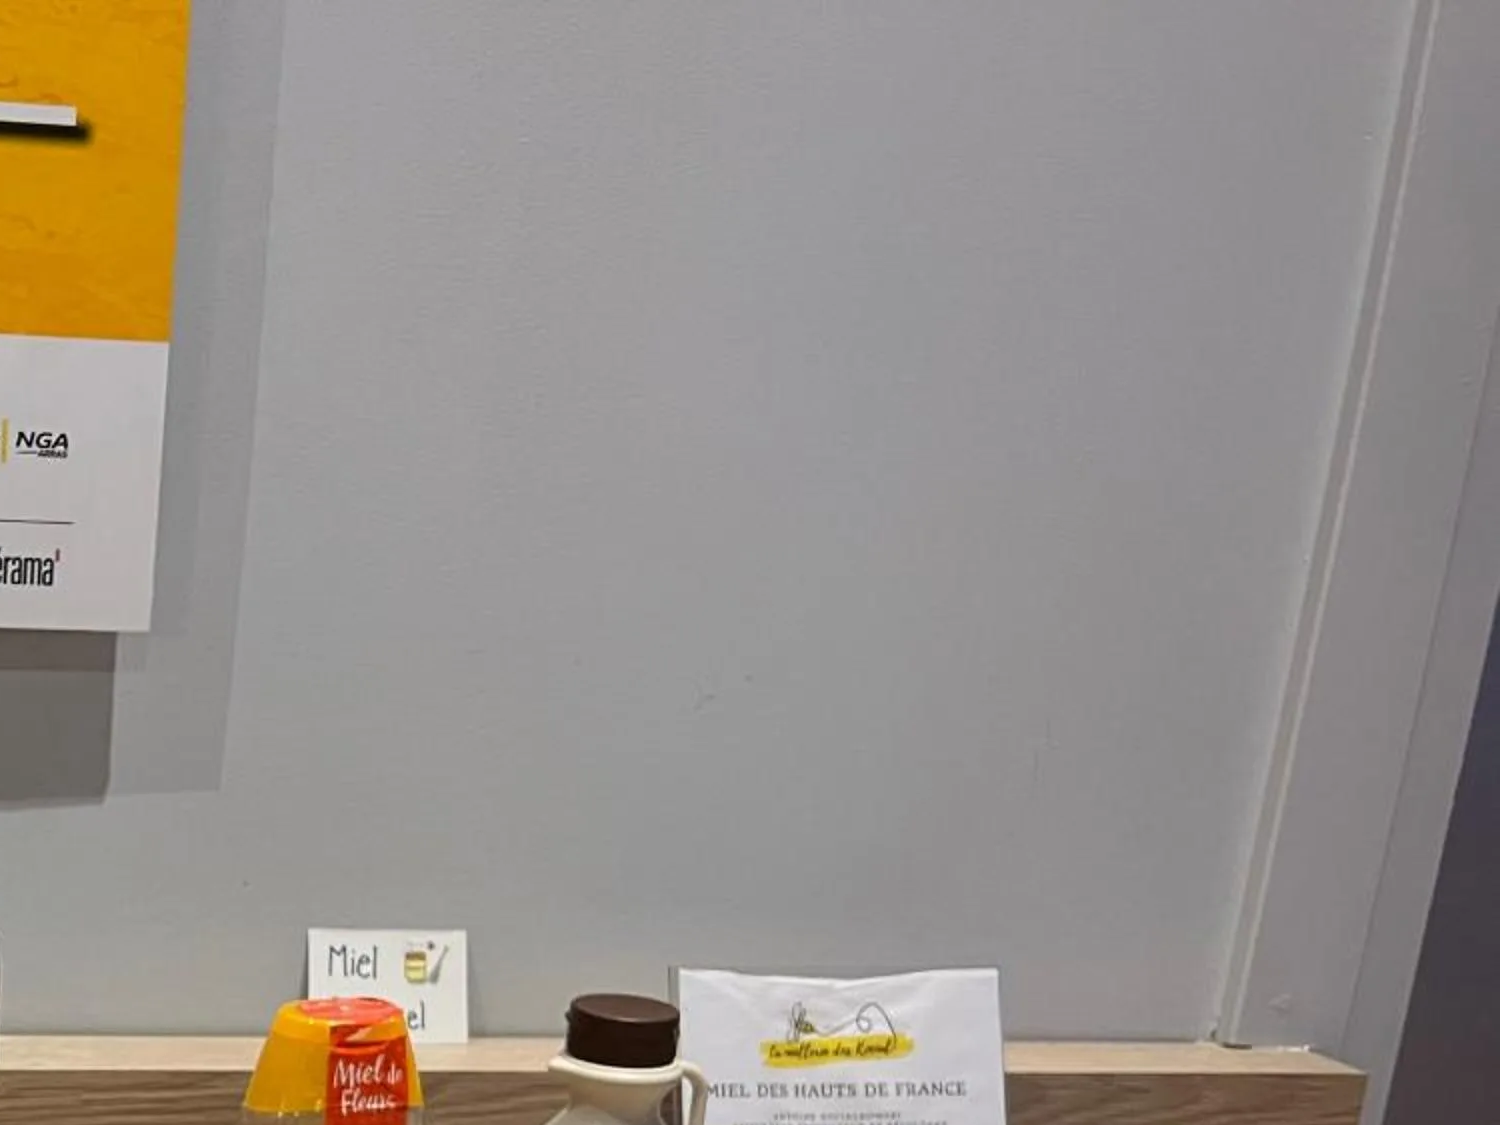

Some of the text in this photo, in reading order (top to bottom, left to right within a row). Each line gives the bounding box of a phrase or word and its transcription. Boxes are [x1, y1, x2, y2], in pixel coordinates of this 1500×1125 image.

[15, 431, 70, 450] NGA
[328, 944, 379, 980] Miel
[407, 1000, 426, 1030] el
[333, 1052, 386, 1089] Miel
[707, 1079, 967, 1100] MIEL DES HAUTS DE FRANCE
